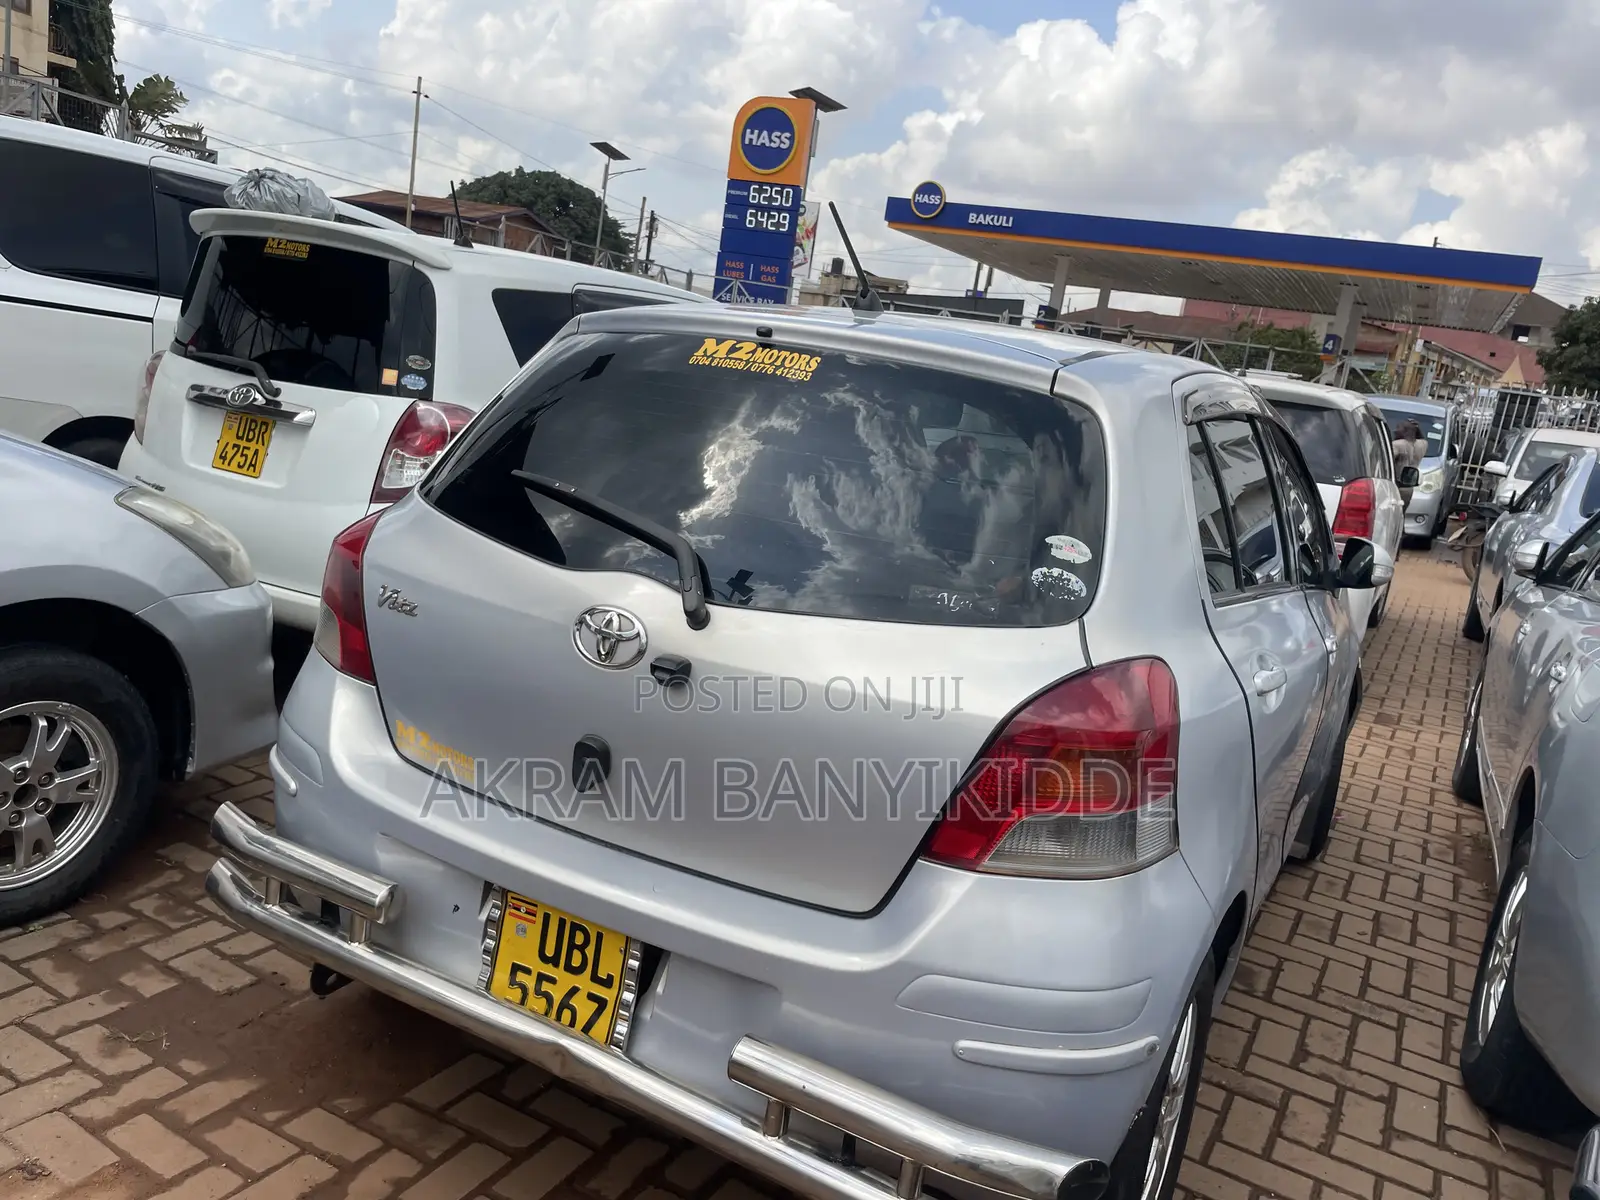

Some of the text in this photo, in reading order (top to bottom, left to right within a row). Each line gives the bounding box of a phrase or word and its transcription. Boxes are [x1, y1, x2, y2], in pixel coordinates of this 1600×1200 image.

[744, 128, 791, 150] HASS
[749, 185, 793, 207] 6250
[914, 193, 941, 205] HASS
[745, 209, 790, 232] 6429
[968, 213, 1013, 227] BAKULI
[265, 237, 311, 252] M2 MOTORS
[723, 269, 745, 279] LUBES
[725, 260, 745, 269] HASS
[760, 265, 780, 274] HASS
[760, 275, 777, 283] GAS
[693, 338, 822, 373] M2 MOTORS
[1324, 340, 1334, 351] 4
[688, 355, 710, 366] 0704
[775, 367, 813, 382] 412393
[236, 415, 270, 446] UBR
[219, 441, 259, 473] 475A
[378, 584, 418, 617] Vitz
[537, 911, 614, 989] UBL
[505, 962, 609, 1036] 5567
